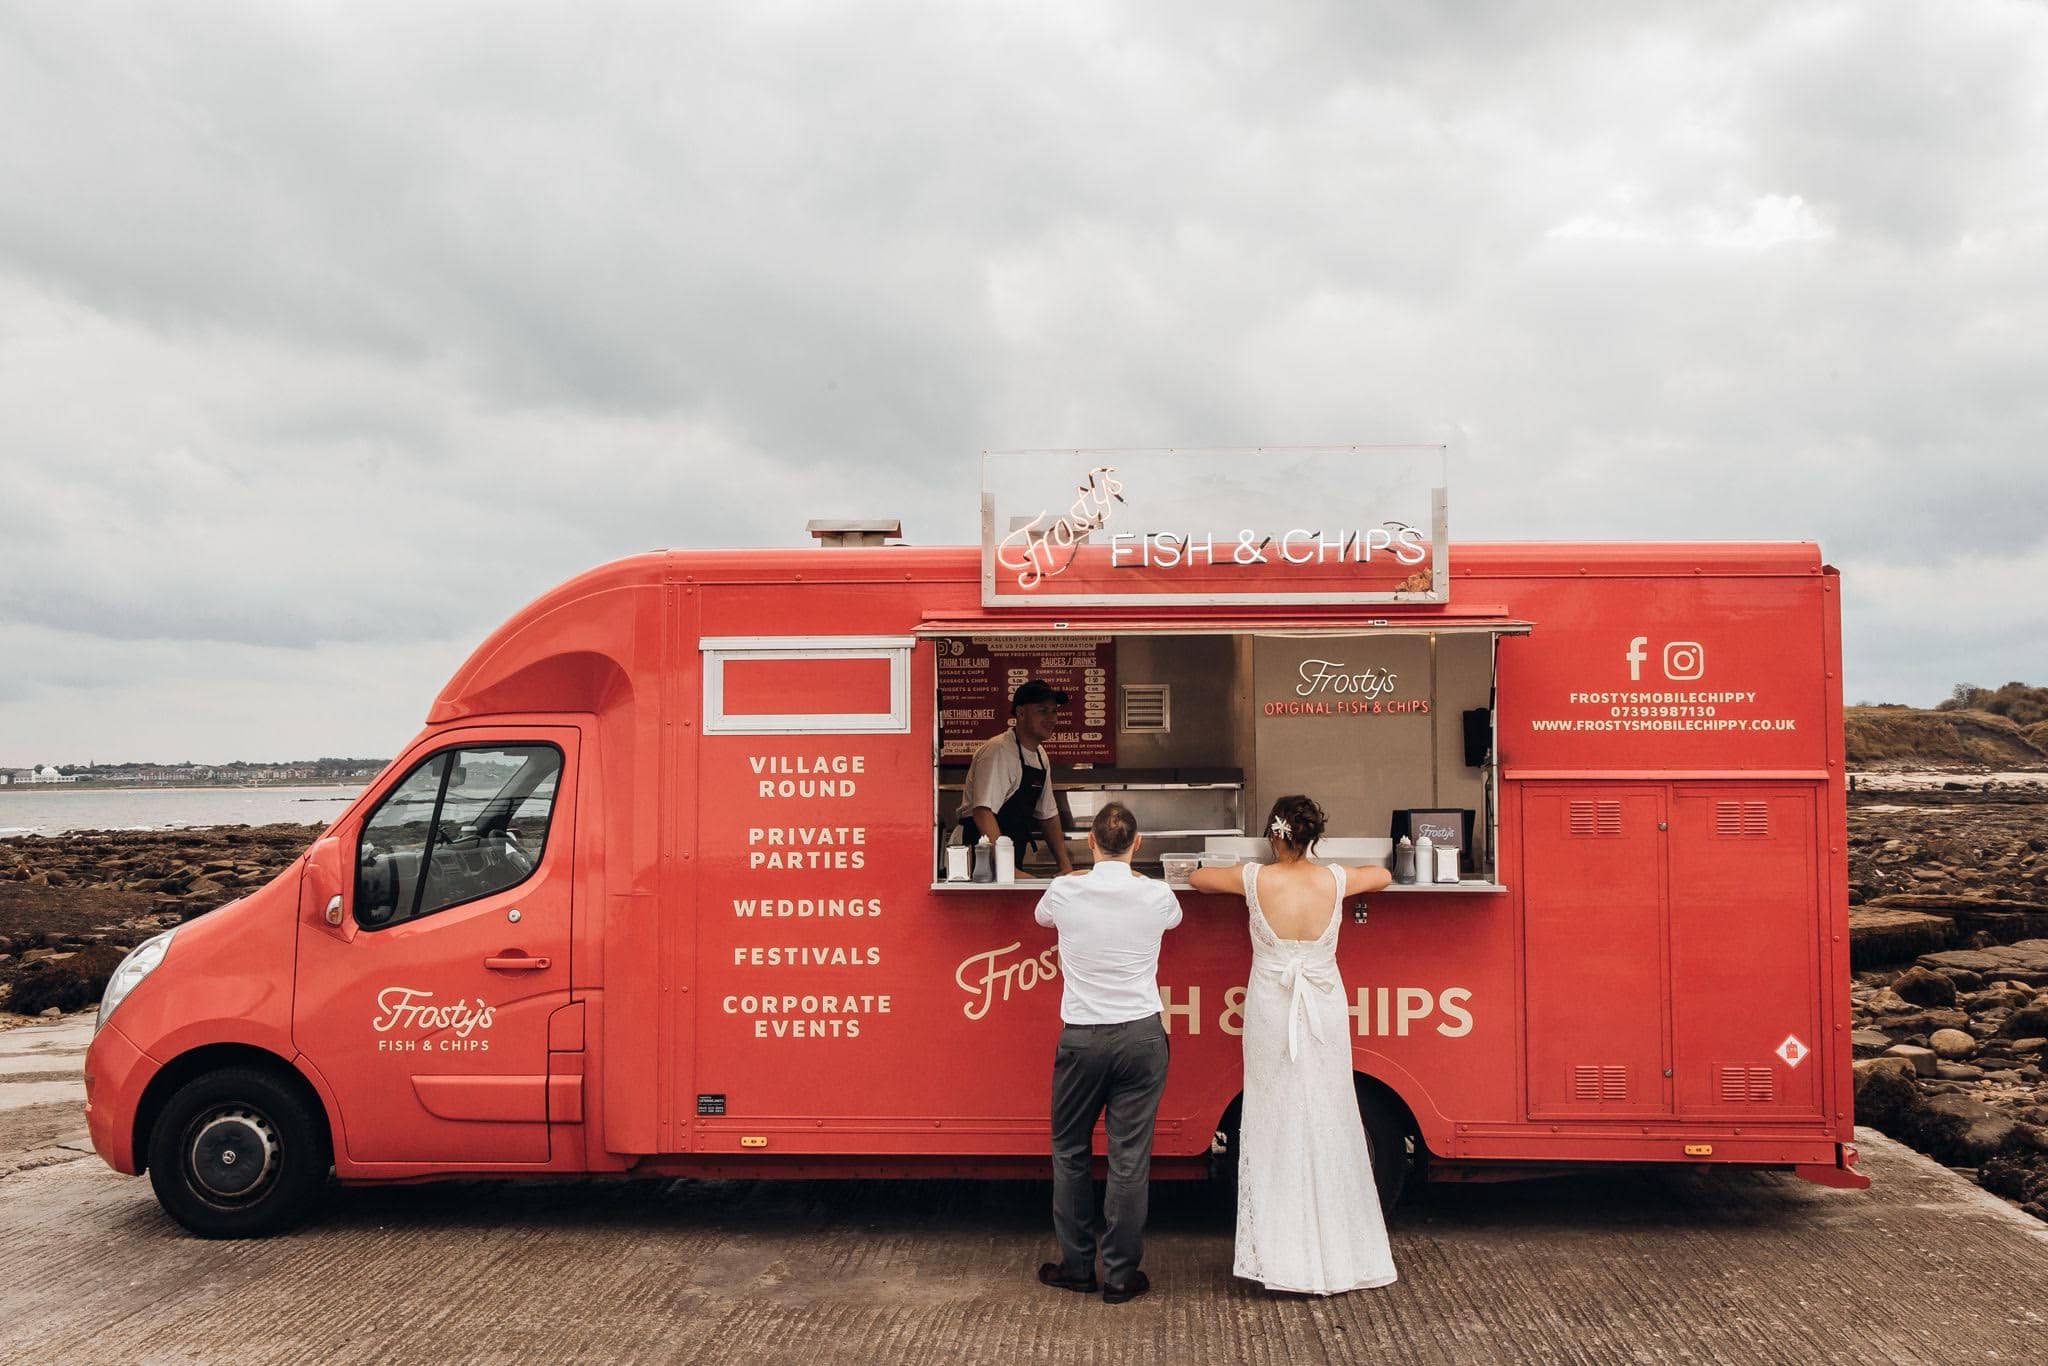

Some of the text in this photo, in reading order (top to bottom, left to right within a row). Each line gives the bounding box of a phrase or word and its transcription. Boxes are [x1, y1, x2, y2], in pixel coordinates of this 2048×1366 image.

[1112, 527, 1425, 569] FISH & CHIPS
[940, 658, 989, 667] FROM THE LAND
[1041, 657, 1066, 667] SAUCES
[1073, 657, 1096, 667] DRINKS
[1570, 692, 1756, 704] FROSTYSMOBILECHIPPY
[972, 709, 995, 718] SWEET
[1264, 700, 1430, 716] ORIGINAL FISH & CHIPS
[1611, 706, 1716, 717] 07393987130
[1532, 719, 1796, 731] WWW.FROSTYSMOBILECHIPPY.CO.UK
[1057, 732, 1080, 741] MEALS
[750, 756, 865, 774] VILLAGE
[759, 780, 857, 798] ROUND
[749, 827, 866, 845] PRIVATE
[750, 851, 865, 870] PARTIES
[733, 898, 882, 917] WEDDINGS
[734, 947, 881, 965] FESTIVALS
[722, 996, 892, 1014] CORPORATE
[1348, 987, 1474, 1038] HIPS
[754, 1020, 861, 1038] EVENTS
[378, 1040, 490, 1051] FISH & CHIPS
